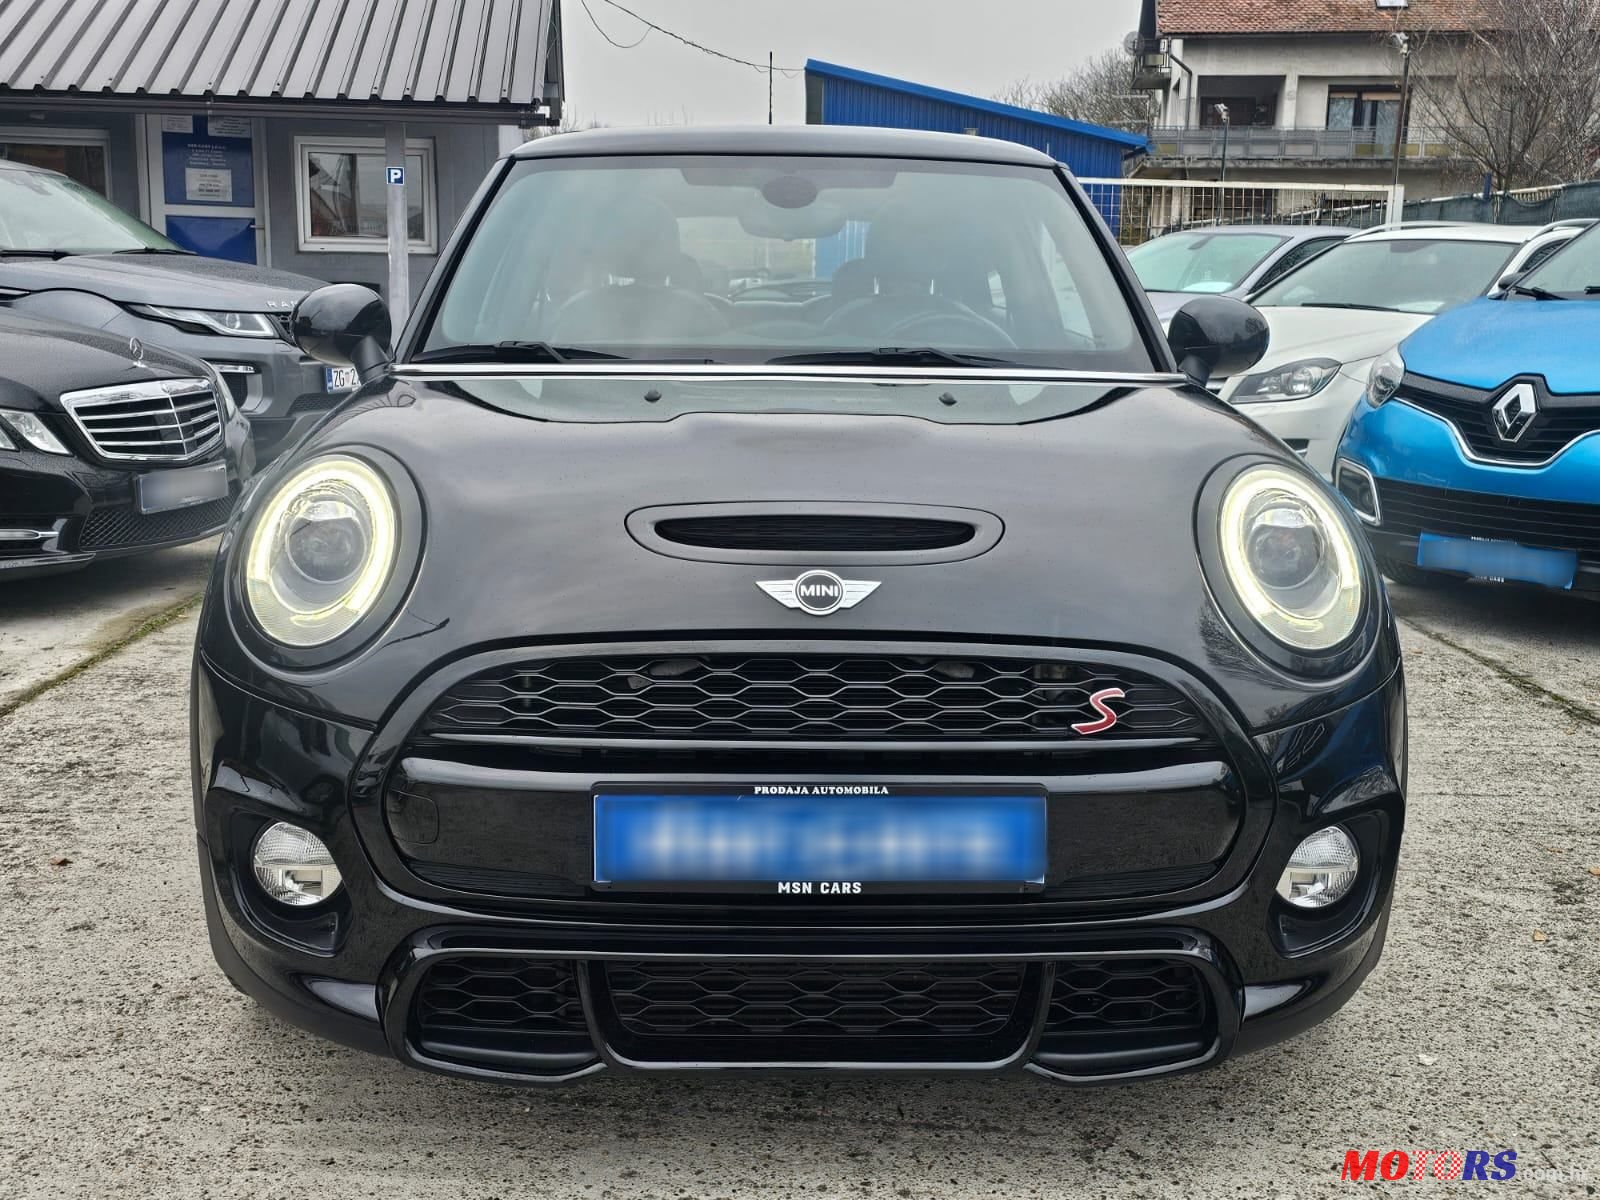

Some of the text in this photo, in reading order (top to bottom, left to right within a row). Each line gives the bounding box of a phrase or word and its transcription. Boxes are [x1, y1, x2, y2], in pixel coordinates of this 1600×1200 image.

[390, 169, 401, 183] P
[333, 369, 345, 388] ZG
[800, 585, 839, 597] MINI
[1070, 687, 1125, 735] S
[754, 786, 889, 795] PRODAJA AUTOMOBILA
[777, 881, 862, 894] MSN CARS
